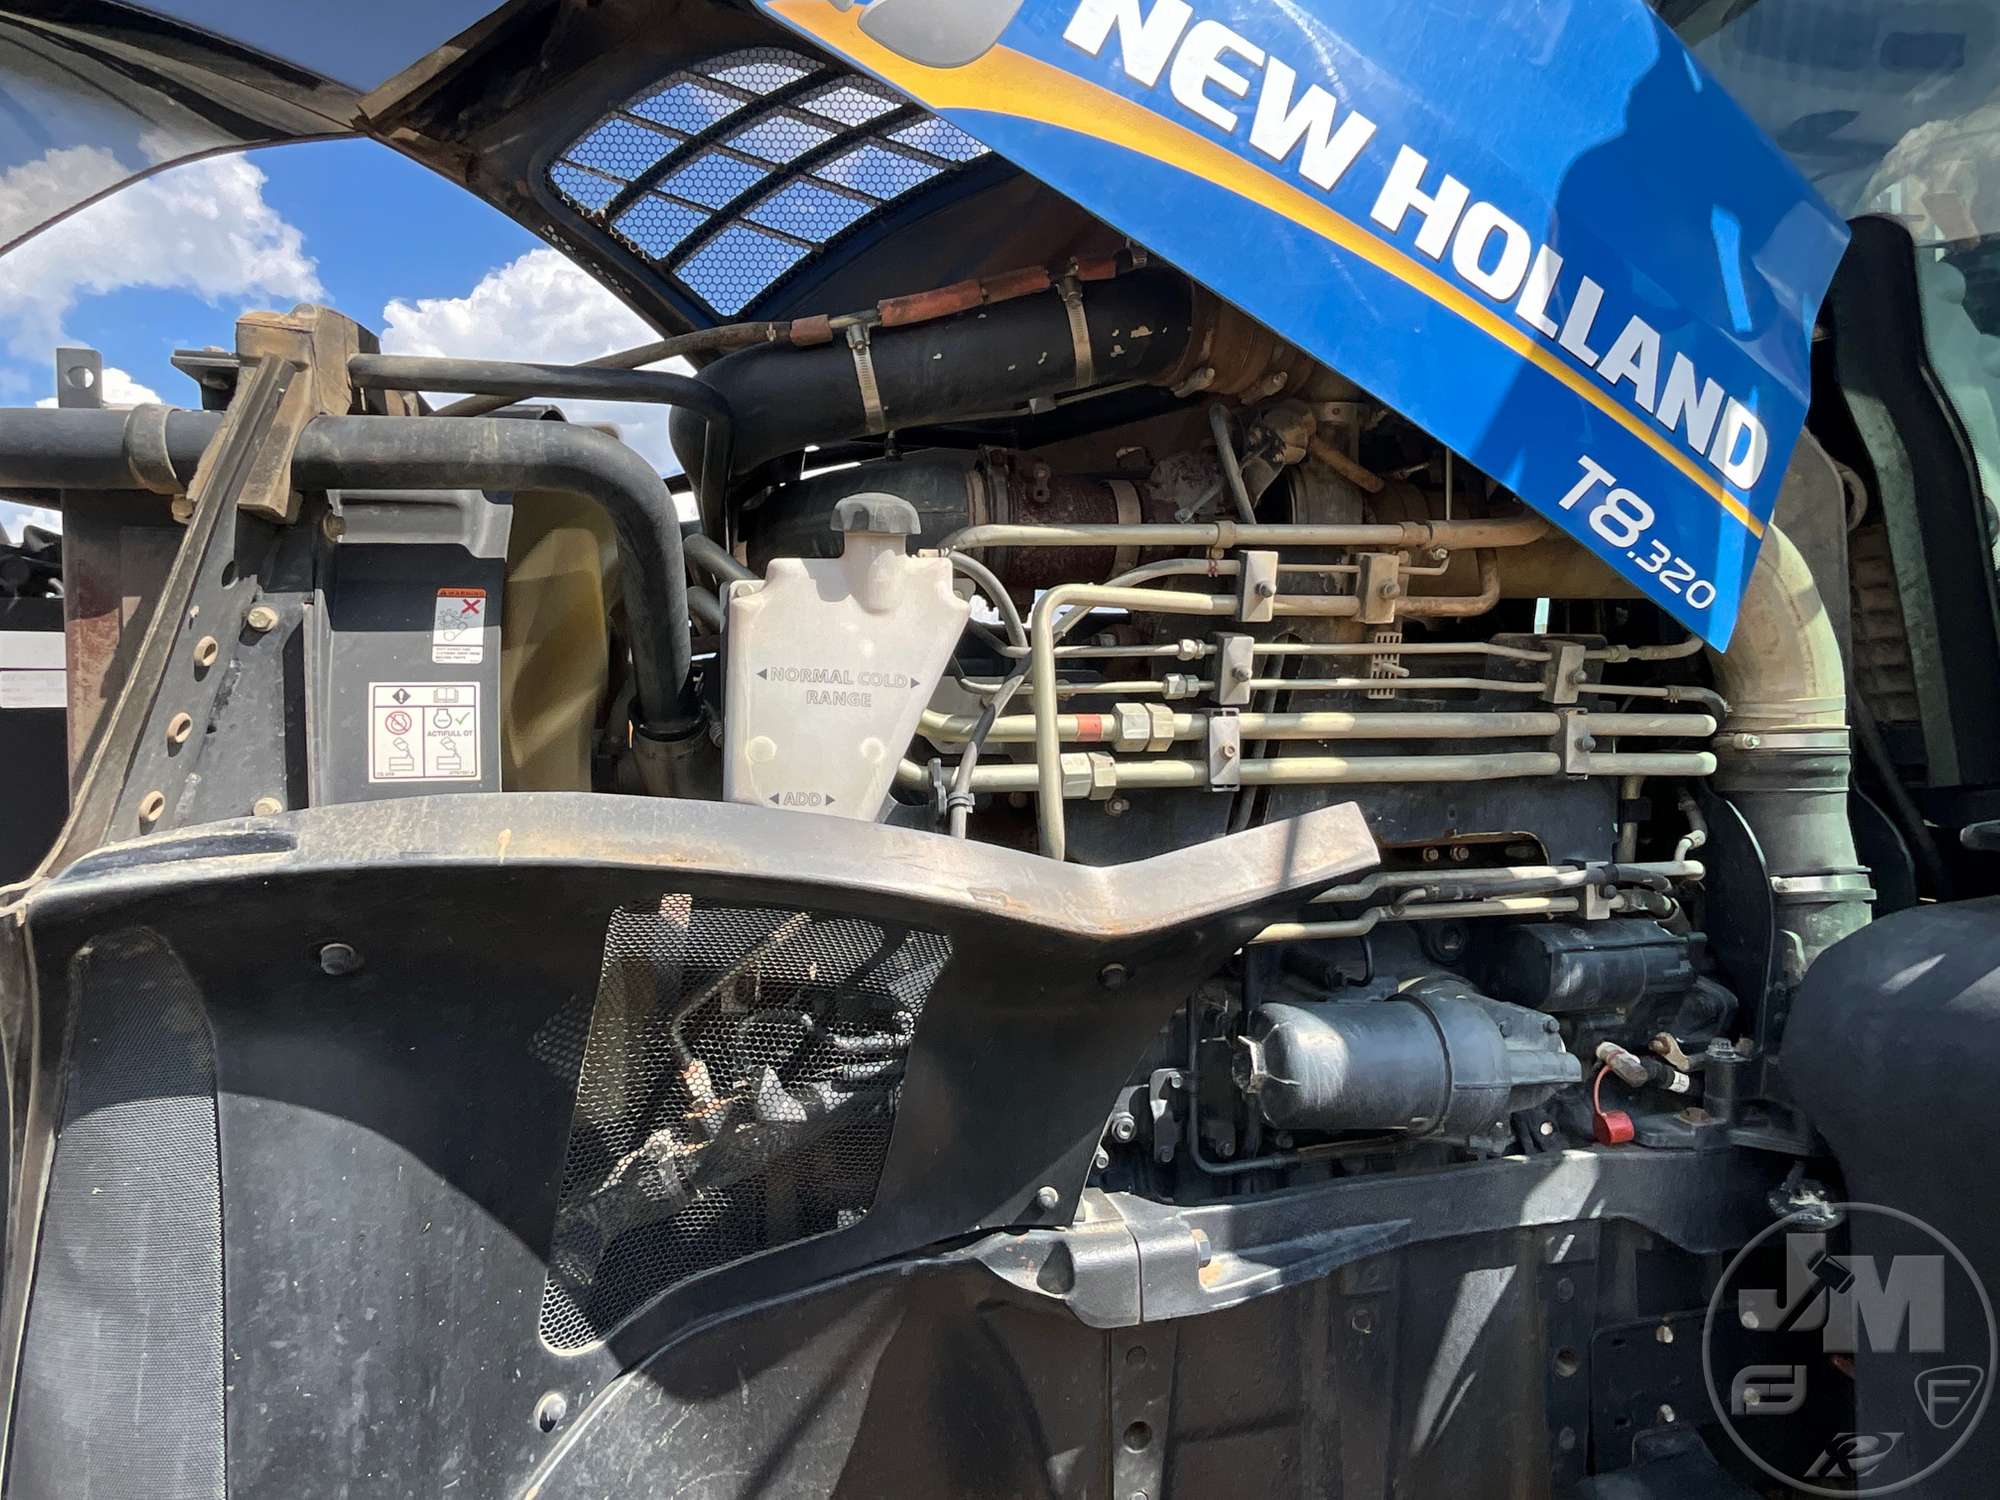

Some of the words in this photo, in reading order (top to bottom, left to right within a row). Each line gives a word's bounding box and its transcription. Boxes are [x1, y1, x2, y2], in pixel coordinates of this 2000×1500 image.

[1062, 0, 1377, 191] NEW
[1370, 143, 1769, 490] HOLLAND
[1558, 454, 1717, 610] T8.320
[770, 666, 855, 685] NORMAL
[857, 671, 908, 689] COLD
[806, 689, 872, 708] RANGE
[427, 729, 462, 737] ACTIFULL
[783, 791, 822, 806] ADD
